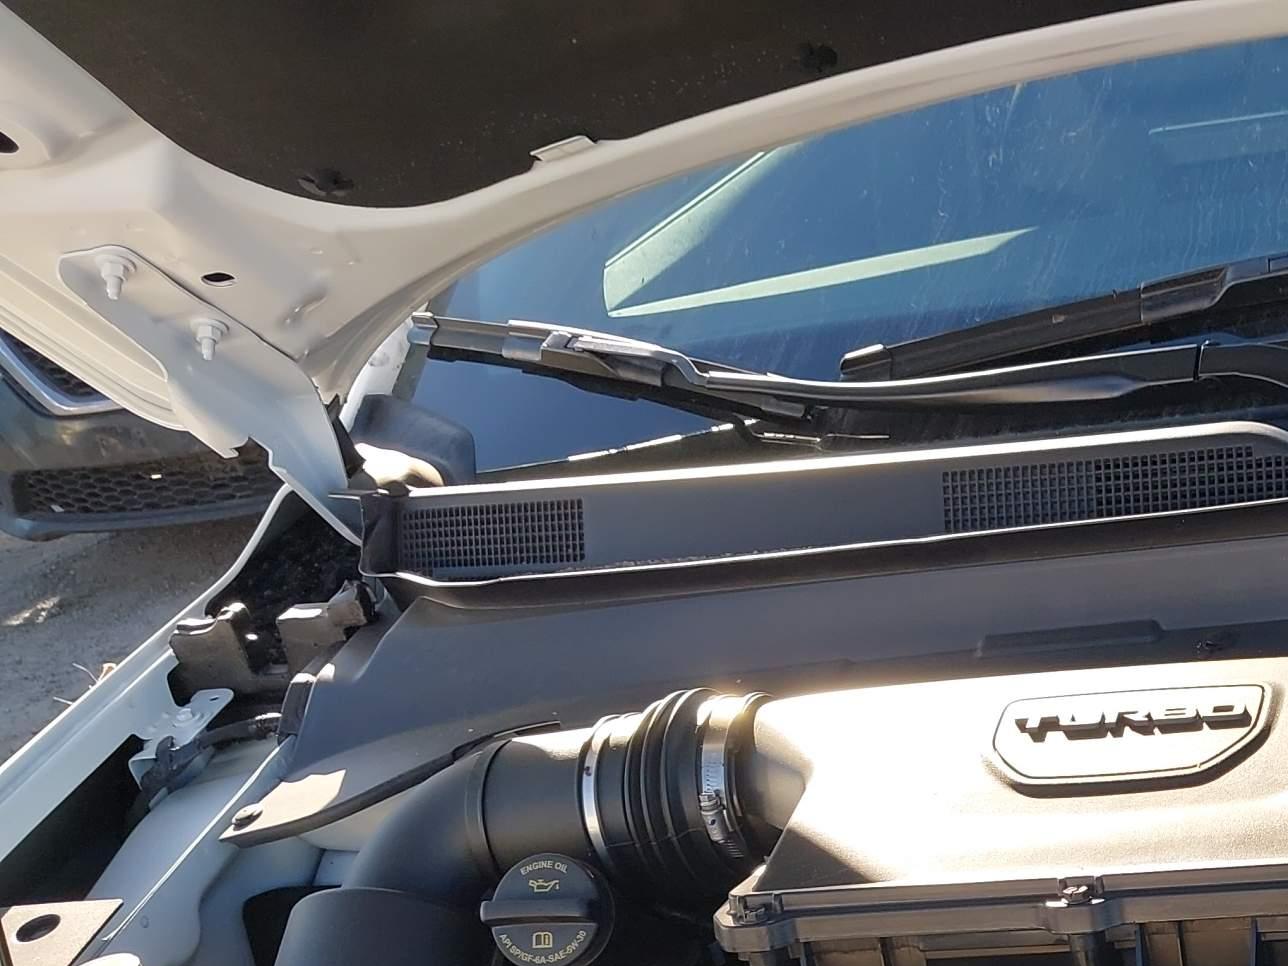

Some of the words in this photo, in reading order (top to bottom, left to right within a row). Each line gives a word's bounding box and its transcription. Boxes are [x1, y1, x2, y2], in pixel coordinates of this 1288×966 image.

[1014, 704, 1253, 743] TURBO
[520, 860, 554, 876] ENGINE
[554, 861, 568, 874] OIL
[498, 934, 511, 949] API
